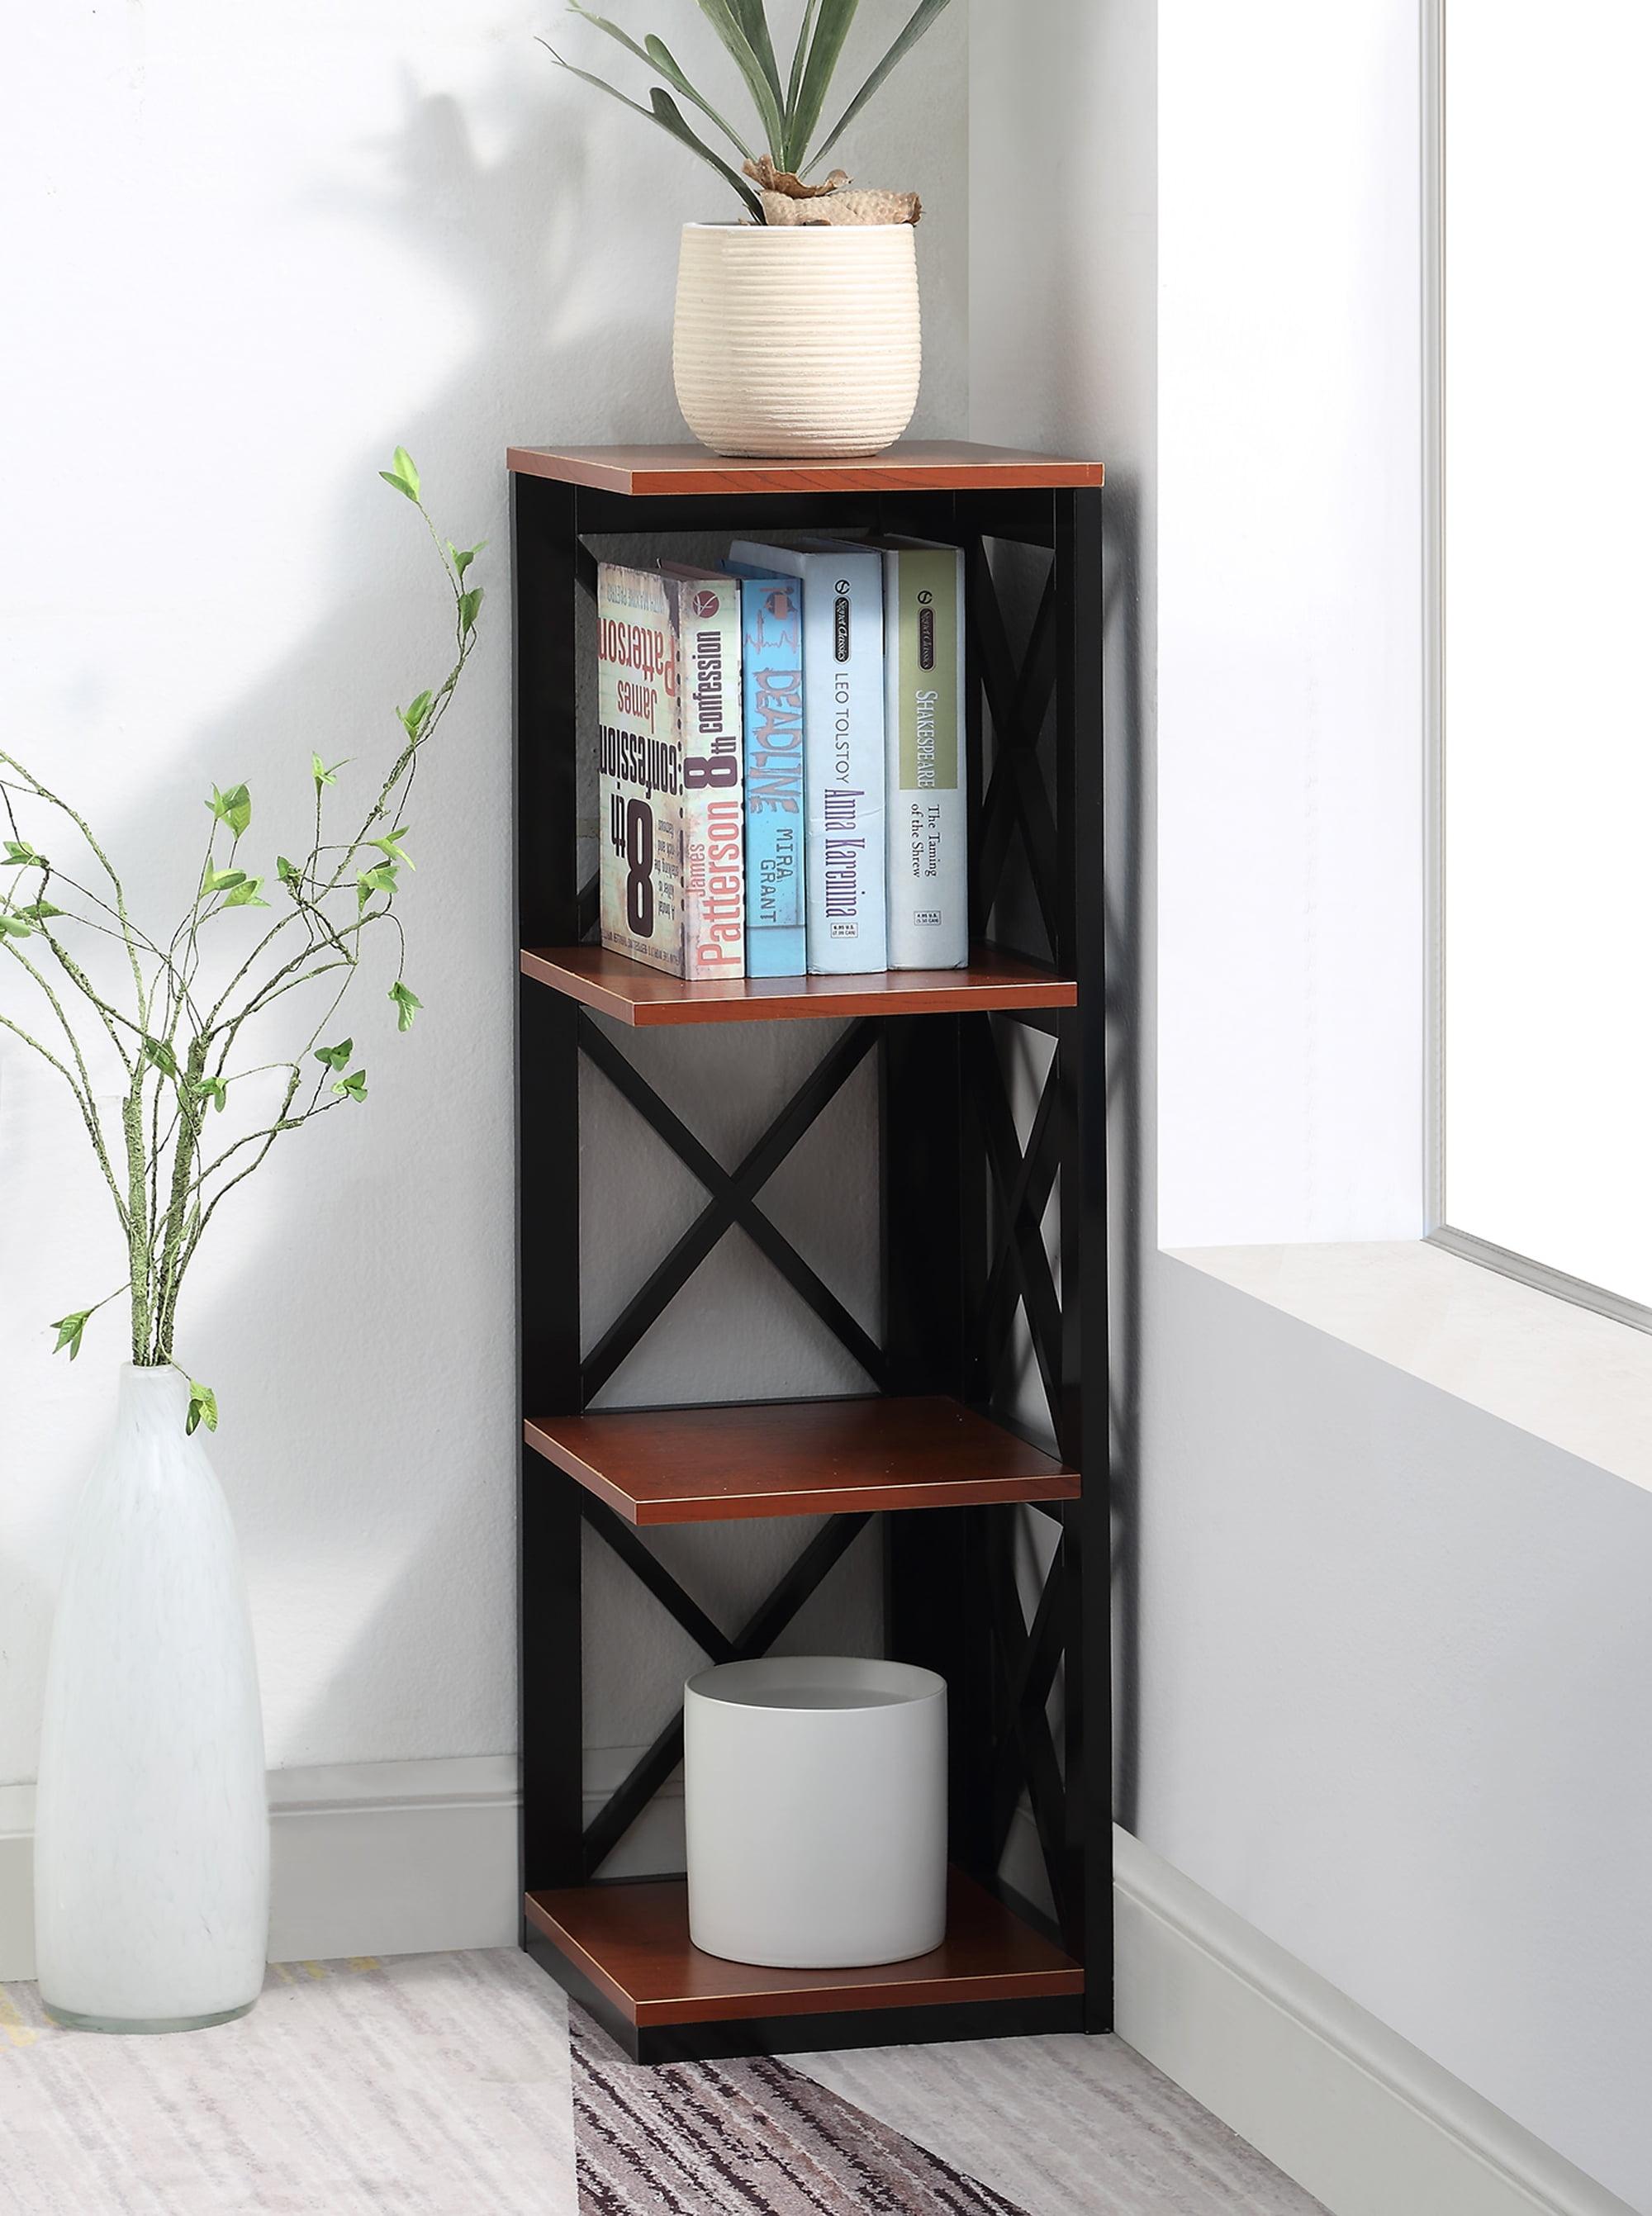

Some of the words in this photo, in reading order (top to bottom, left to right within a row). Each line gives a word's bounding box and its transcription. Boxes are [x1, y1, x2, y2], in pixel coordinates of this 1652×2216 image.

[597, 619, 676, 697] Patterson
[692, 630, 722, 734] confession
[617, 681, 657, 734] James
[834, 672, 849, 704] LEO
[600, 725, 678, 800] confession
[683, 735, 738, 790] 8th
[748, 667, 803, 814] DEADLINE
[835, 708, 850, 784] TOLSTOY
[915, 689, 938, 790] SHAKESPEARE
[824, 789, 865, 832] Anna
[910, 804, 923, 819] of
[911, 818, 923, 838] the
[928, 804, 940, 828] The
[610, 794, 654, 938] 8th
[686, 843, 705, 898] James
[776, 828, 794, 880] MIRA
[825, 838, 866, 918] Karenina
[911, 839, 924, 878] Shrew
[924, 833, 940, 877] Taming
[696, 800, 742, 966] Patterson
[760, 859, 777, 923] GRANT
